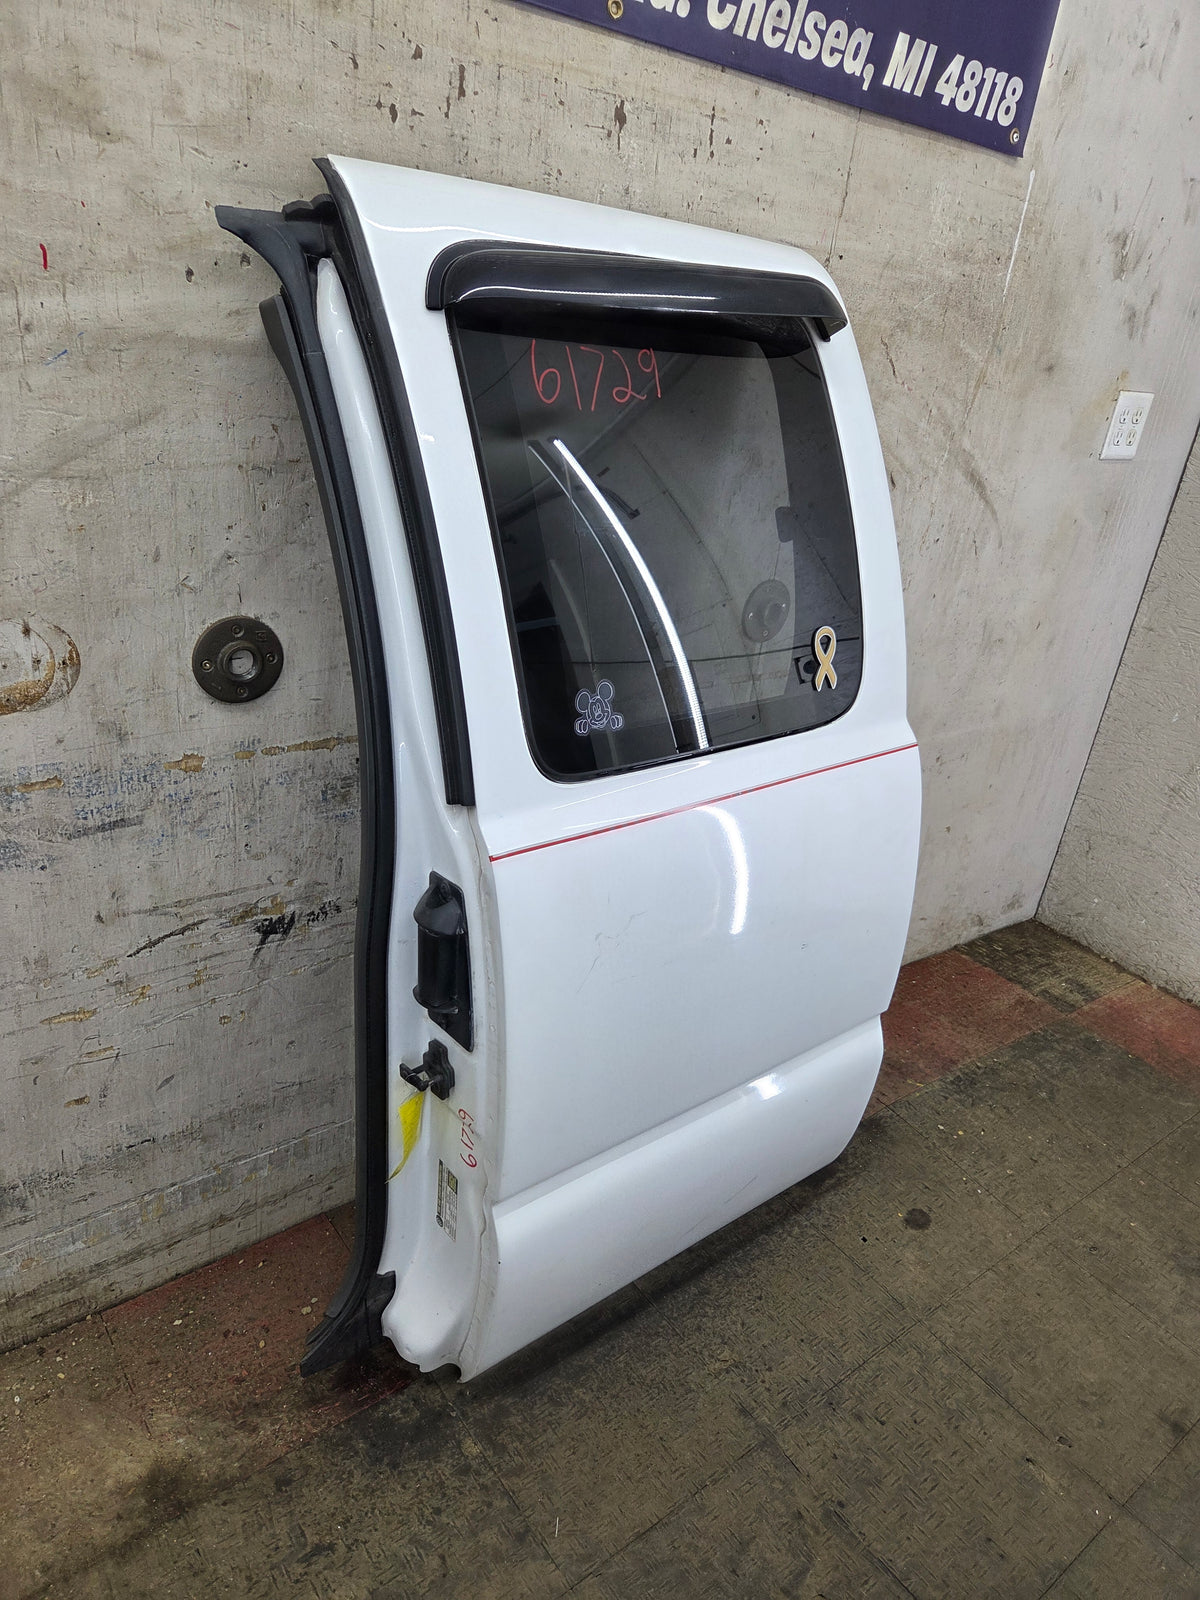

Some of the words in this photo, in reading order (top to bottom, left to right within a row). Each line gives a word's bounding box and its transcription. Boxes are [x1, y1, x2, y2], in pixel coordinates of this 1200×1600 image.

[882, 31, 938, 97] MI
[934, 53, 1024, 127] 48118
[529, 338, 662, 412] 61729
